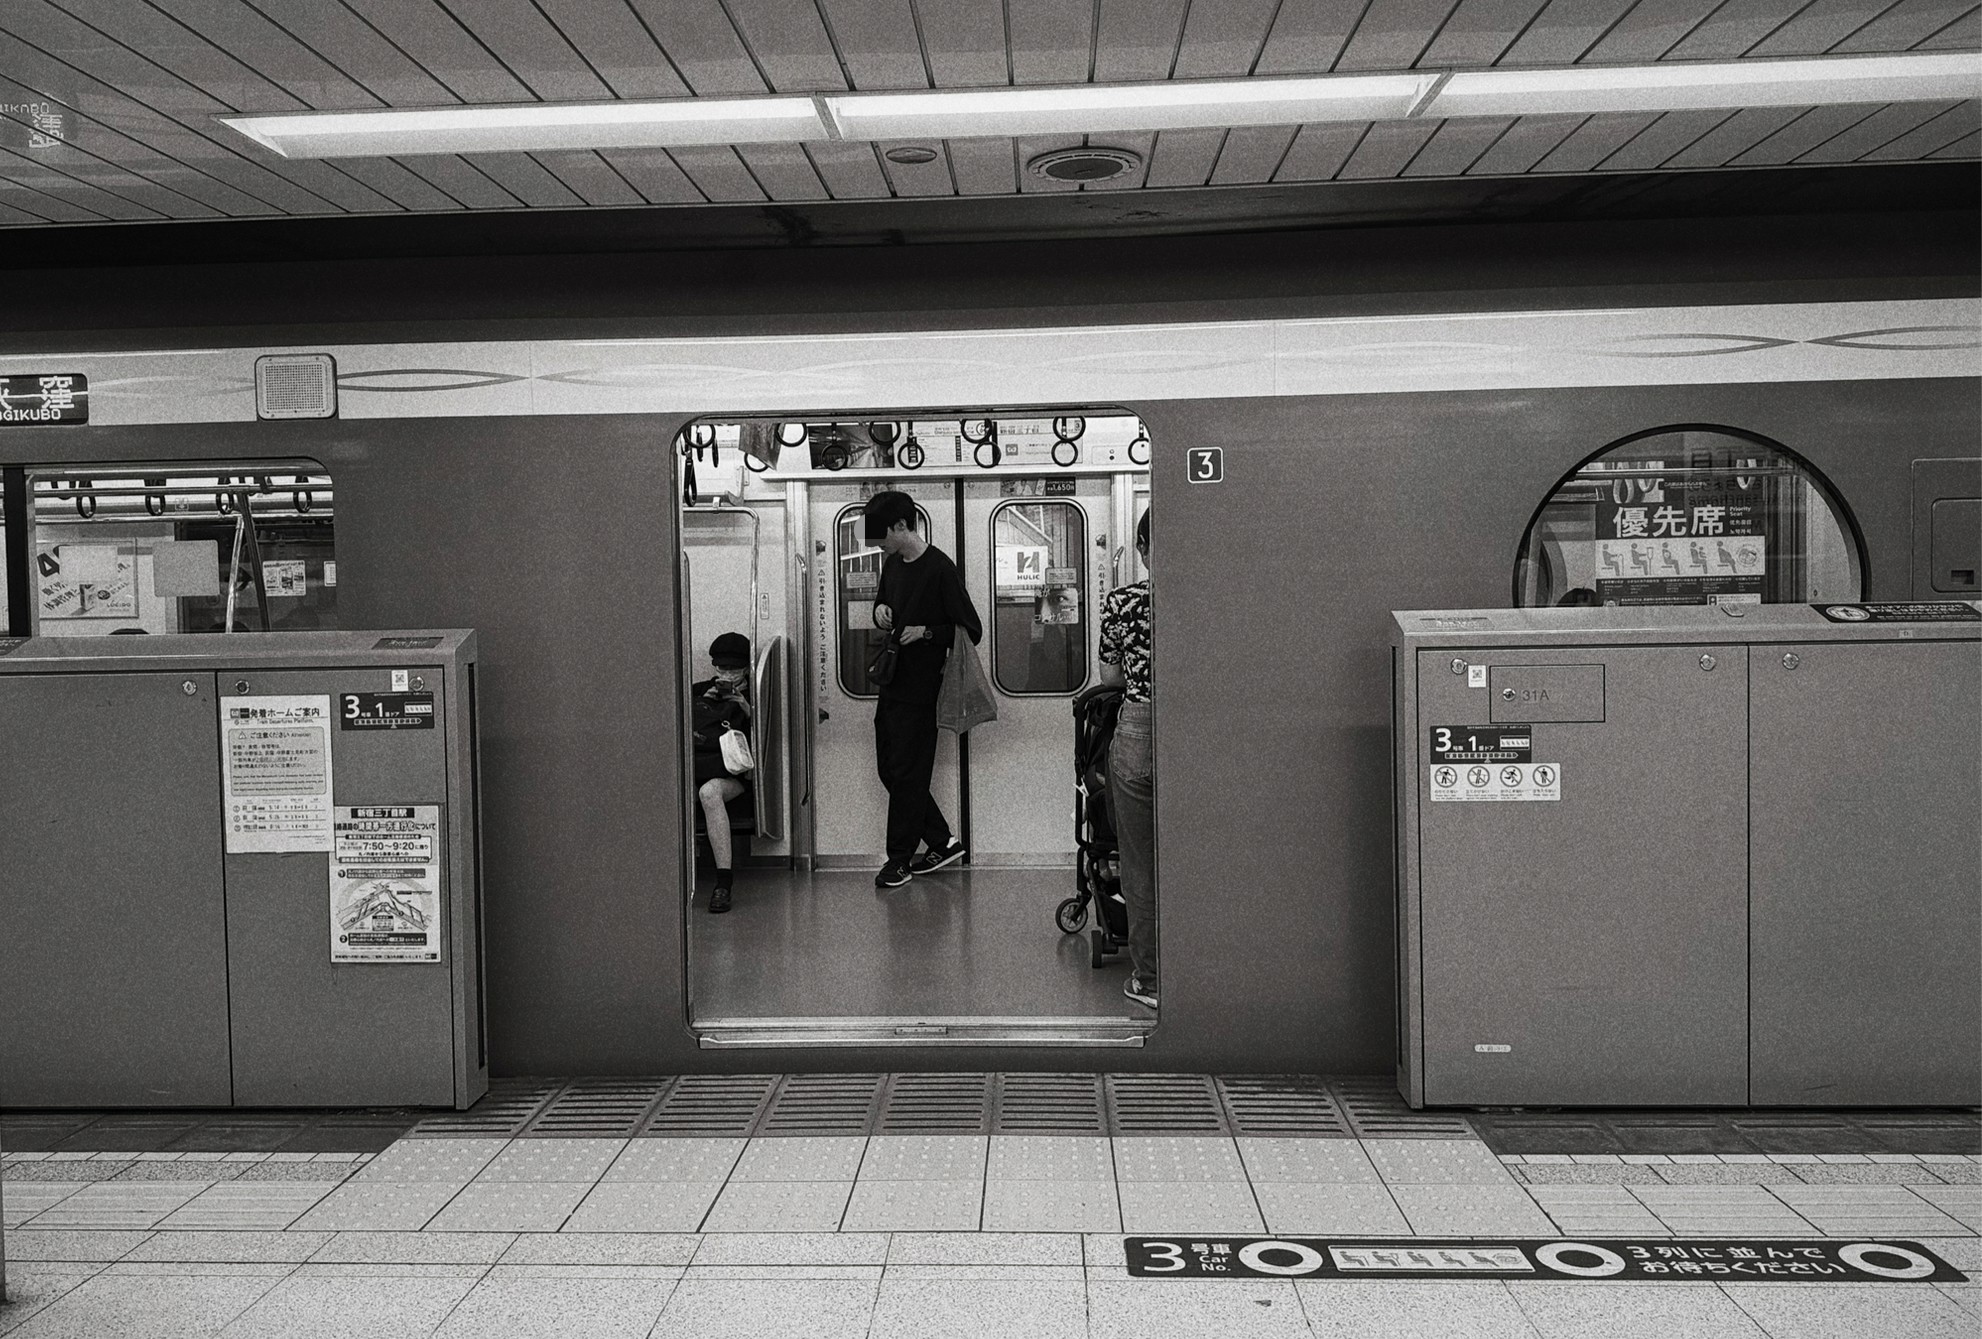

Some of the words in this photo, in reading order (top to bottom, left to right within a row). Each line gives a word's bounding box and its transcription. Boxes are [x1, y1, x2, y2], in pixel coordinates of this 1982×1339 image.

[0, 408, 61, 421] GIKUBO
[1198, 452, 1214, 479] 3
[1612, 504, 1726, 538] 優先席
[1522, 689, 1550, 701] 31A
[250, 707, 320, 719] 発着ホームご案内
[357, 808, 408, 818] 新宿三丁目駅
[1191, 1243, 1232, 1255] 号車
[1626, 1246, 1826, 1259] 3列に並んで
[1143, 1242, 1187, 1272] 3
[1199, 1255, 1229, 1263] Car
[1201, 1263, 1231, 1271] No.
[1639, 1260, 1846, 1274] お待ちください
